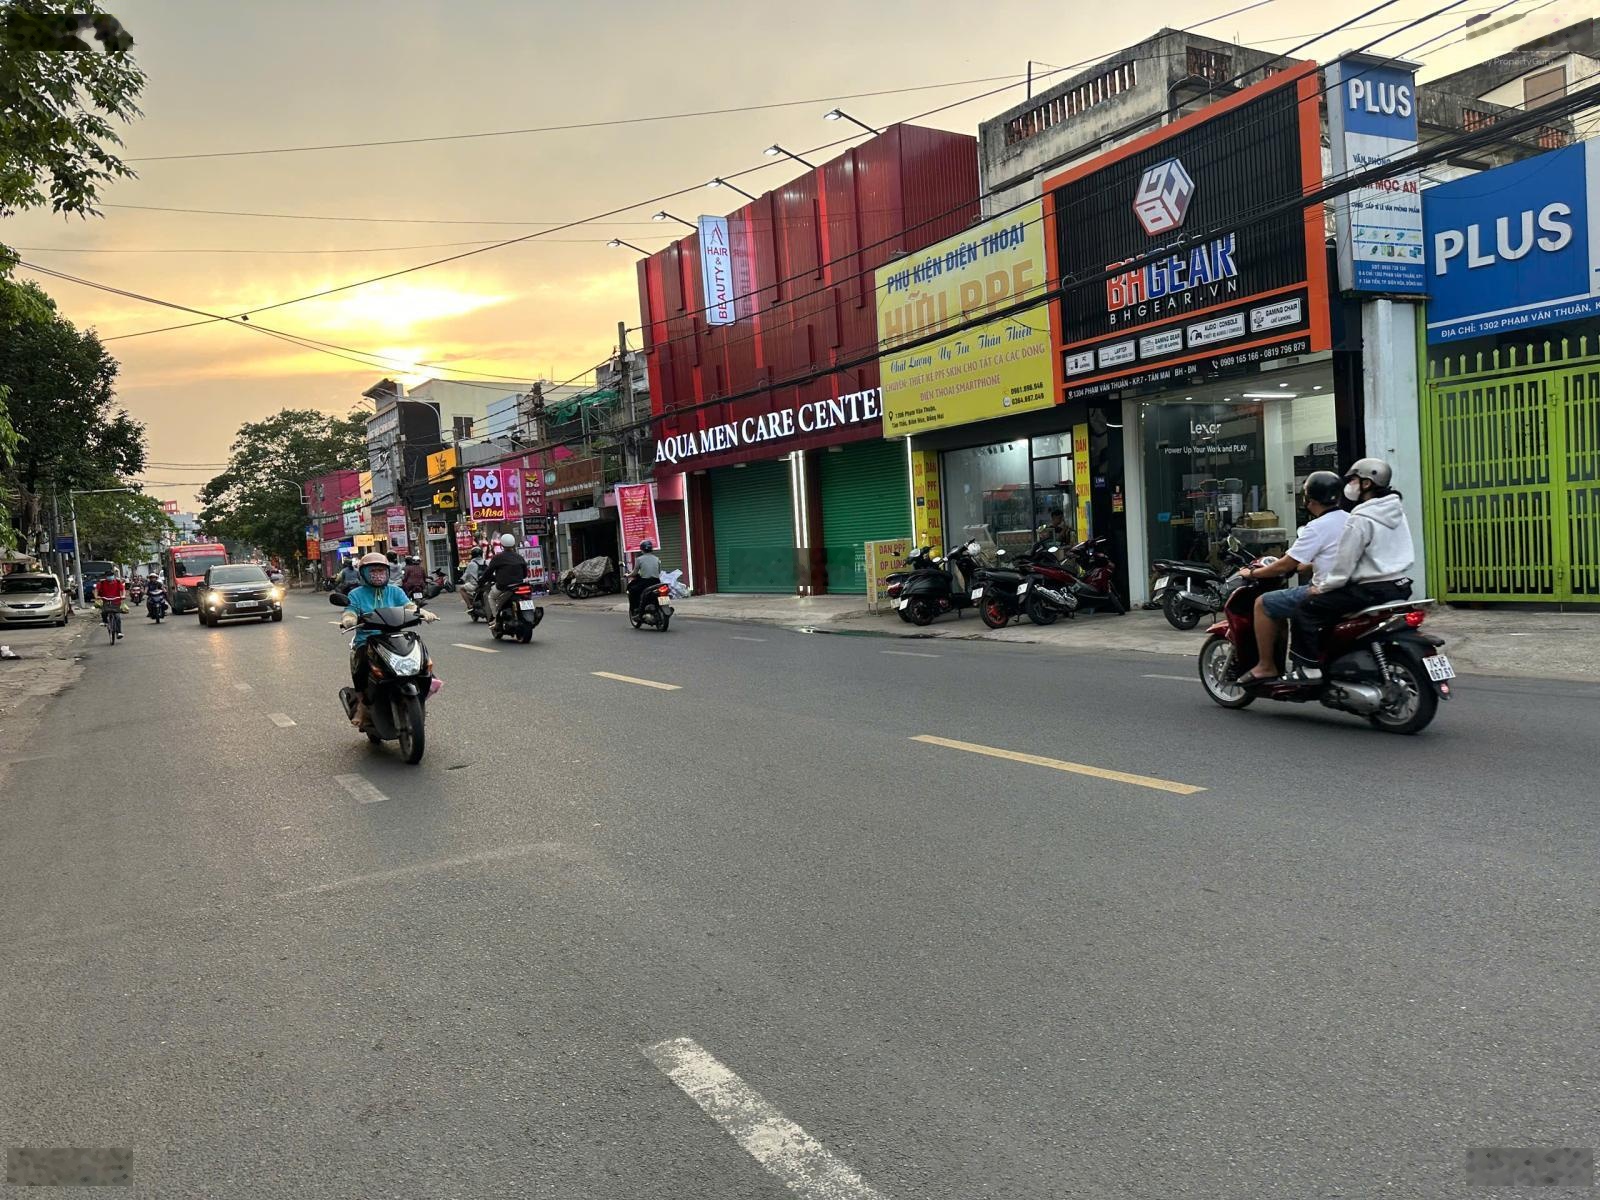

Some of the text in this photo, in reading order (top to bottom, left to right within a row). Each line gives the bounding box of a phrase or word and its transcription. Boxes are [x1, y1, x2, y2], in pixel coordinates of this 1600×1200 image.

[1348, 78, 1411, 117] PLUS
[1402, 180, 1417, 194] AN
[706, 246, 728, 256] HAIR
[1434, 202, 1573, 276] PLUS
[887, 221, 1026, 295] PHỤ KIỆN ĐIỆN THOẠI
[1106, 232, 1238, 312] BHGEAR
[714, 266, 728, 319] BEAUTY
[1110, 279, 1237, 325] BHGEAR.VN
[1283, 303, 1298, 312] CHAIR
[1441, 328, 1456, 339] ĐỊA
[1479, 321, 1499, 331] 1302
[1501, 314, 1529, 327] PHẠM
[1531, 309, 1551, 321] VĂN
[1553, 303, 1592, 317] THUẬN,
[1220, 357, 1235, 367] 0909
[1264, 348, 1280, 358] 0819
[1293, 341, 1306, 351] 879
[1160, 370, 1171, 379] MAI
[1174, 367, 1184, 376] BH
[655, 432, 697, 464] AQUA
[700, 421, 739, 454] MEN
[741, 408, 796, 444] CARE
[1183, 446, 1192, 455] Up
[1192, 445, 1205, 453] Your
[1233, 444, 1248, 452] PLAY
[473, 470, 499, 490] ĐỒ
[472, 489, 503, 507] LÓT
